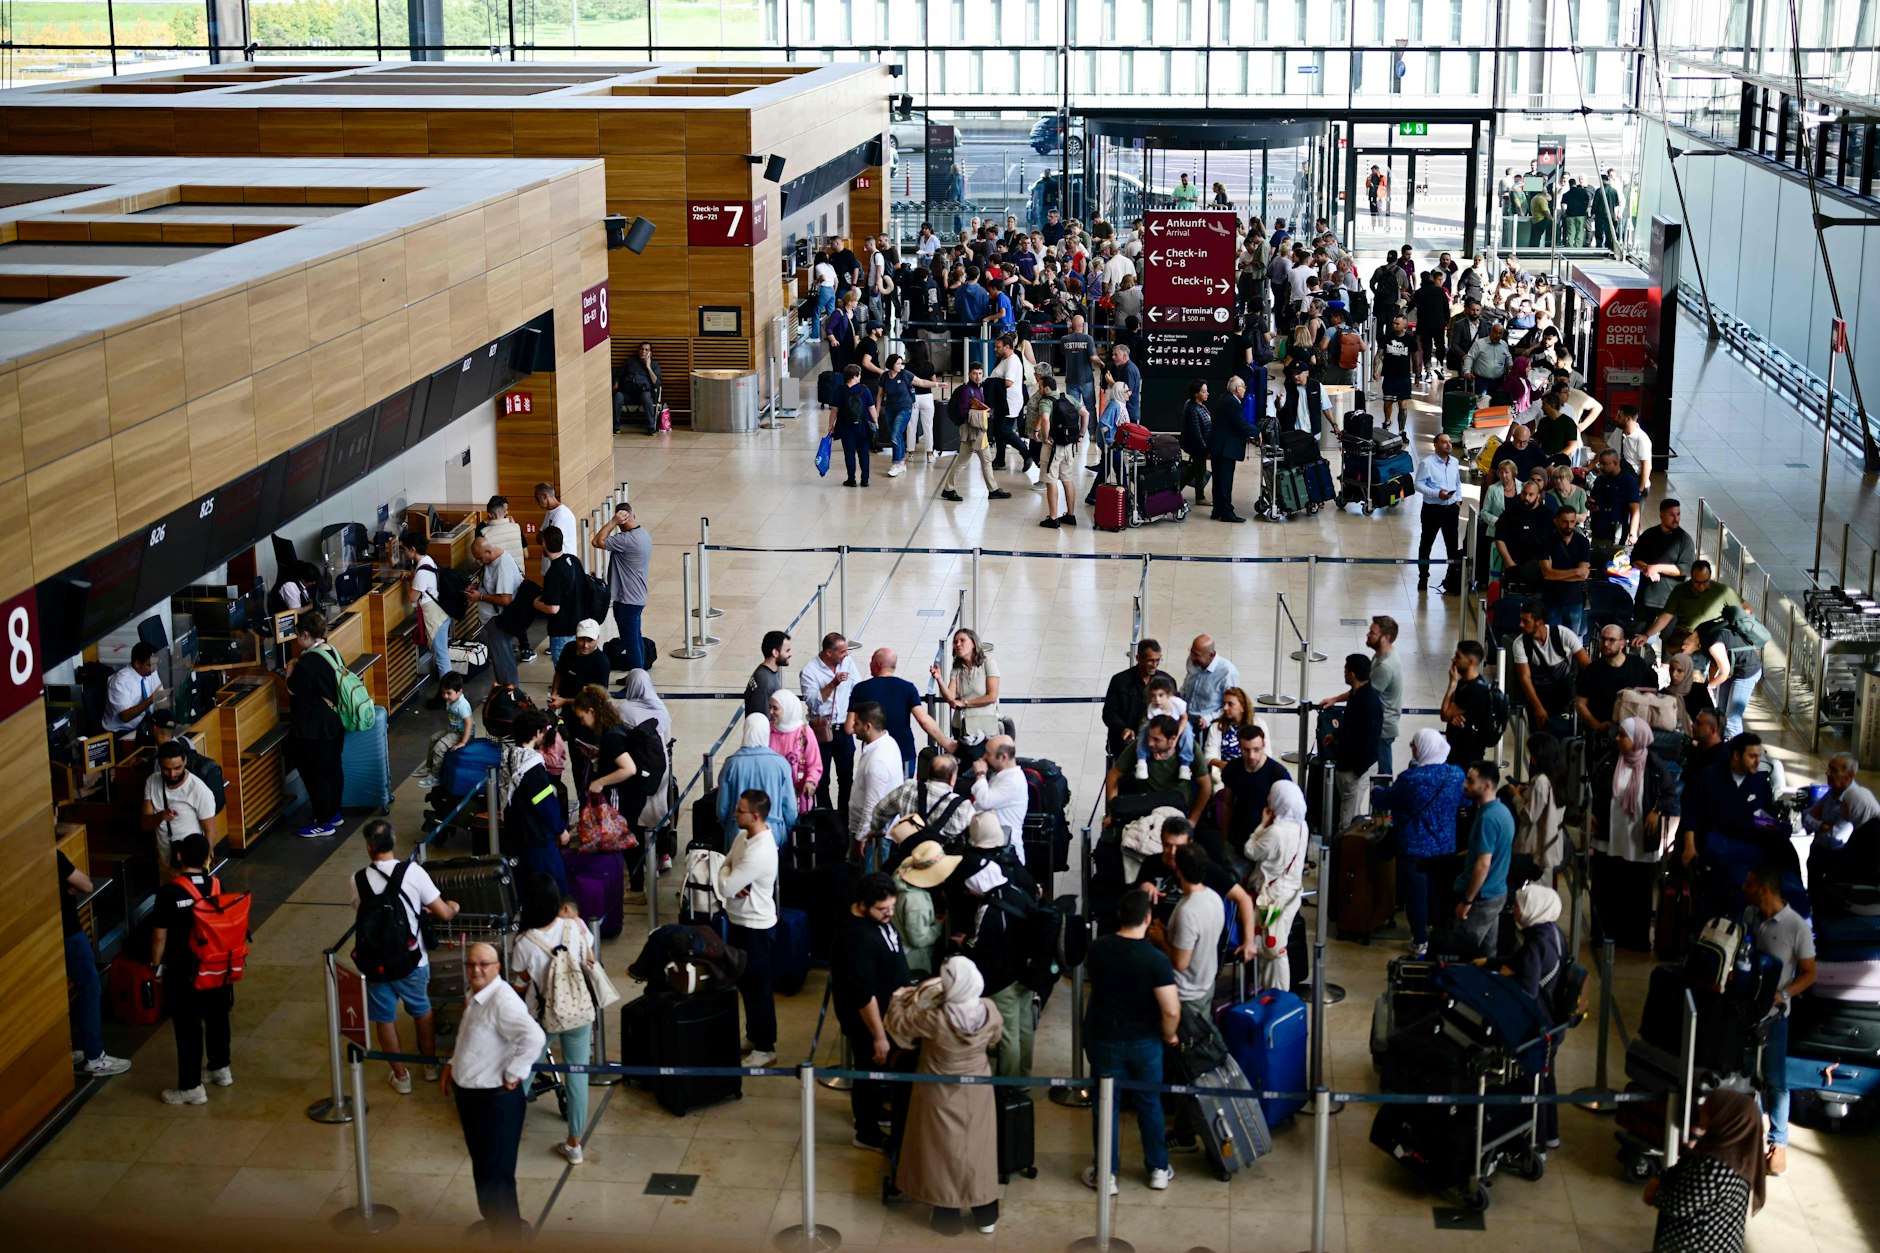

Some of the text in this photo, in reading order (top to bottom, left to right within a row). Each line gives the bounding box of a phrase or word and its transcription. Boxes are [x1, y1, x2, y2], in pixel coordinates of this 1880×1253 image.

[724, 206, 744, 238] 7
[1166, 218, 1206, 228] Ankunft
[1166, 228, 1190, 236] Arrival
[1166, 248, 1208, 258] Check-in
[1166, 259, 1186, 268] 0–8
[1172, 276, 1213, 286] Check-in
[1206, 286, 1213, 296] 9
[600, 287, 608, 329] 8
[1182, 307, 1213, 315] Terminal
[1606, 300, 1648, 318] Coca-Co
[1606, 334, 1646, 344] BERLI
[199, 497, 214, 518] 825
[150, 524, 166, 546] 826
[8, 606, 34, 686] 8
